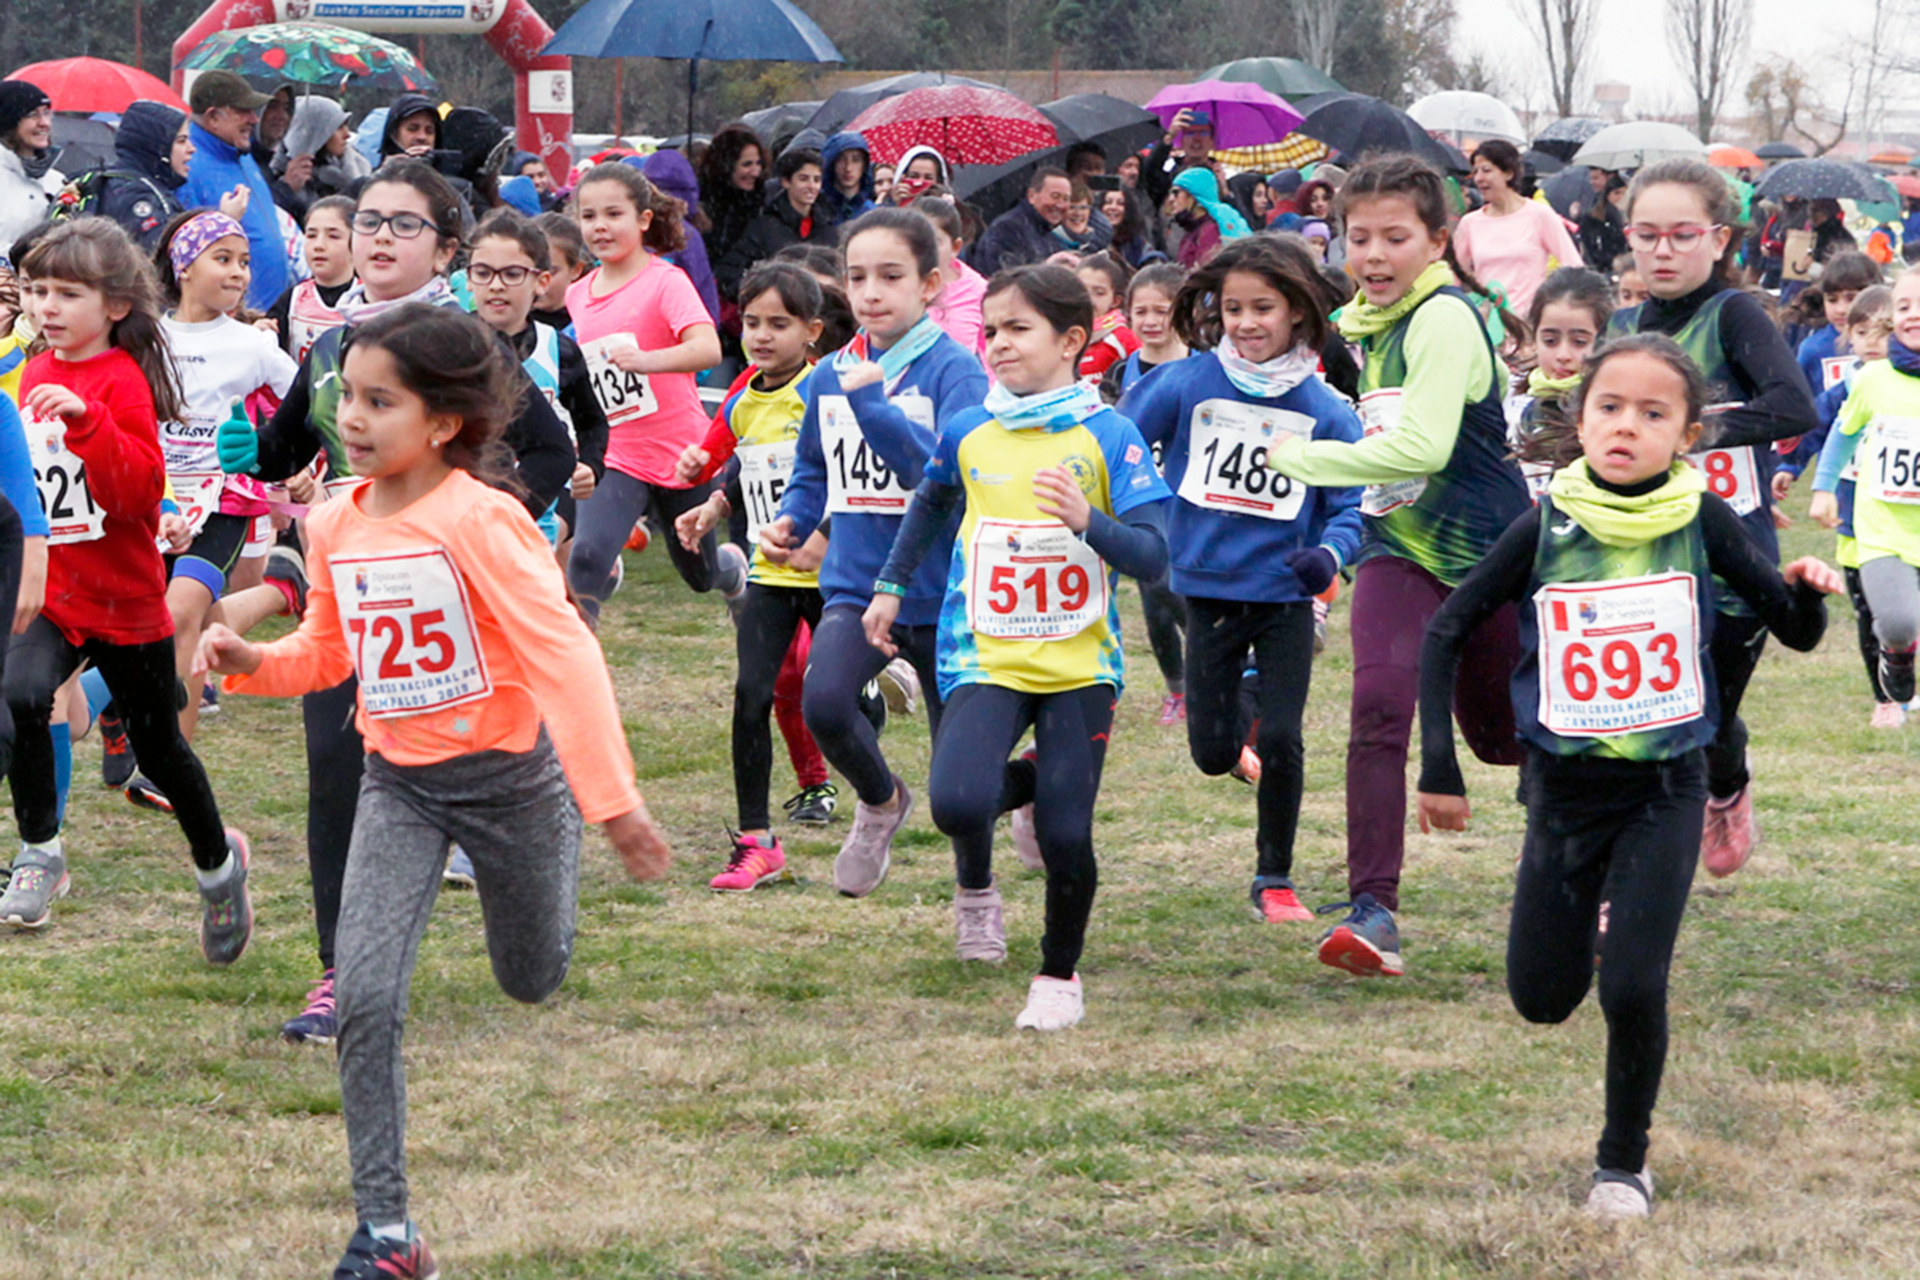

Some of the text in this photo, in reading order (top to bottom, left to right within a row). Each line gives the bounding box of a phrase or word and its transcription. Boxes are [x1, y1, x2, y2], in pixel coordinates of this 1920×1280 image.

[317, 4, 463, 18] Asuntos Sociales y Deportes
[593, 368, 643, 410] 134
[988, 564, 1090, 615] 519
[348, 608, 456, 681] 725
[400, 671, 460, 692] NACIONAL
[461, 666, 478, 679] DE
[1561, 632, 1682, 702] 693
[437, 682, 470, 702] 2019
[1588, 702, 1624, 715] CROSS
[1626, 693, 1682, 711] NACIONAL
[1563, 711, 1652, 727] CANTIMPALOS
